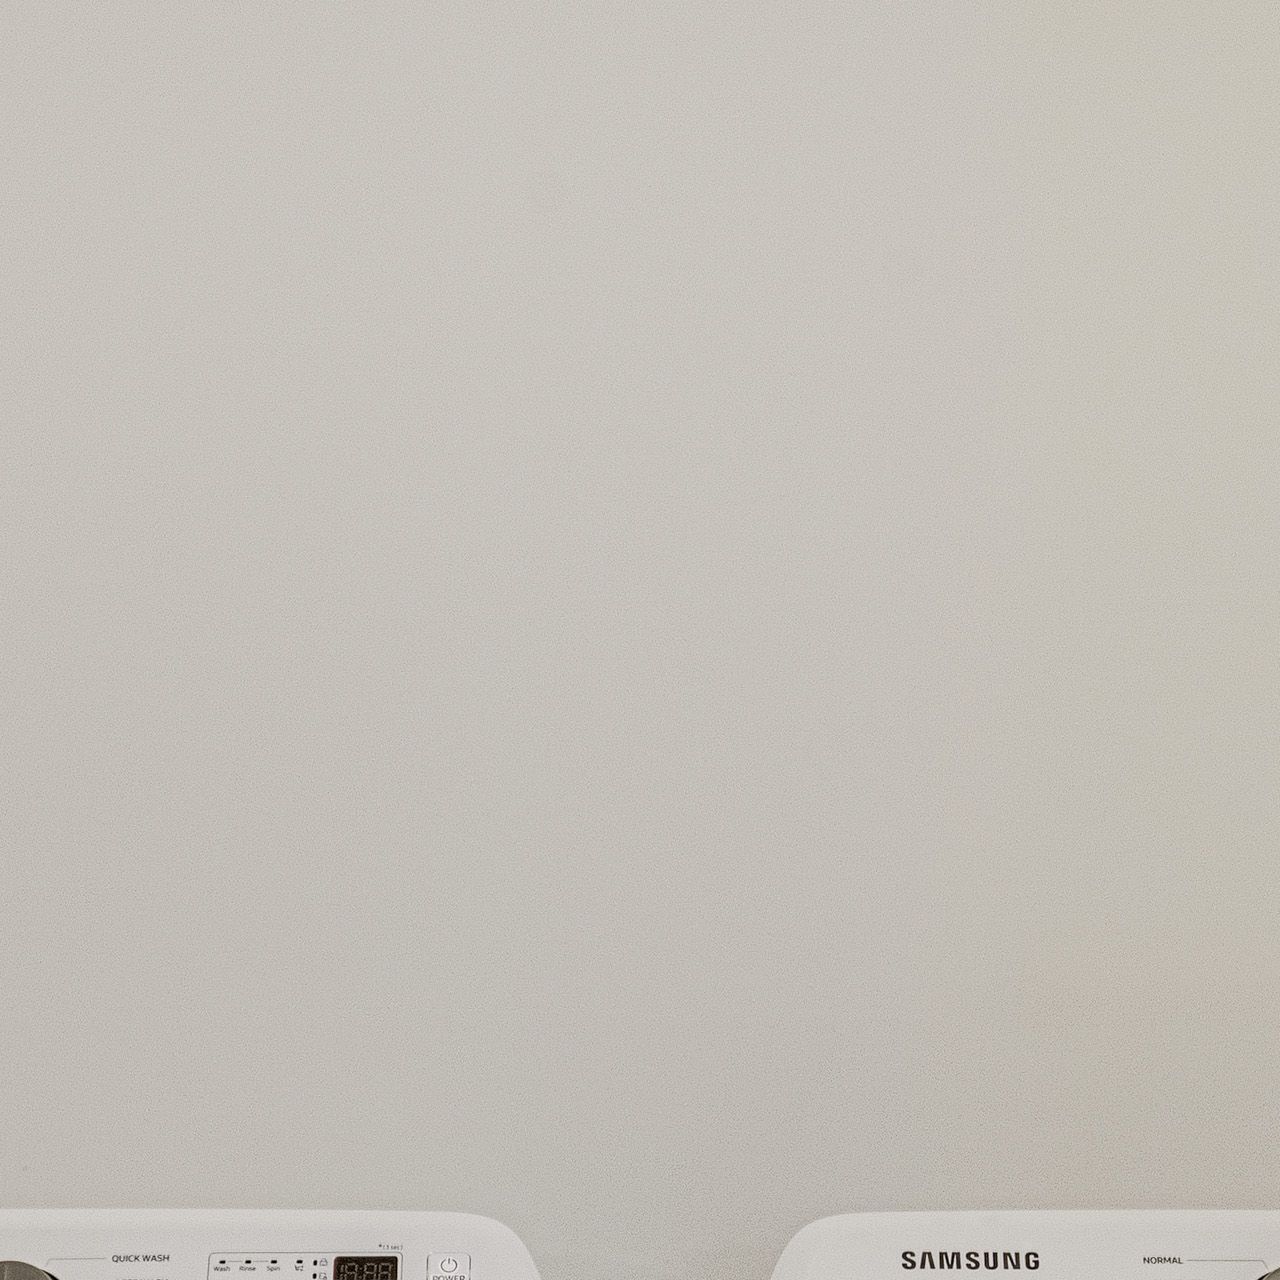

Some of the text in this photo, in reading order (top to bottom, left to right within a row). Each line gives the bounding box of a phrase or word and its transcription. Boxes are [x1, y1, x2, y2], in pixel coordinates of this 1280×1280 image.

[111, 1254, 170, 1263] QUICK WASH
[901, 1251, 1040, 1270] SAMSUNG
[1142, 1256, 1183, 1265] NORMAL
